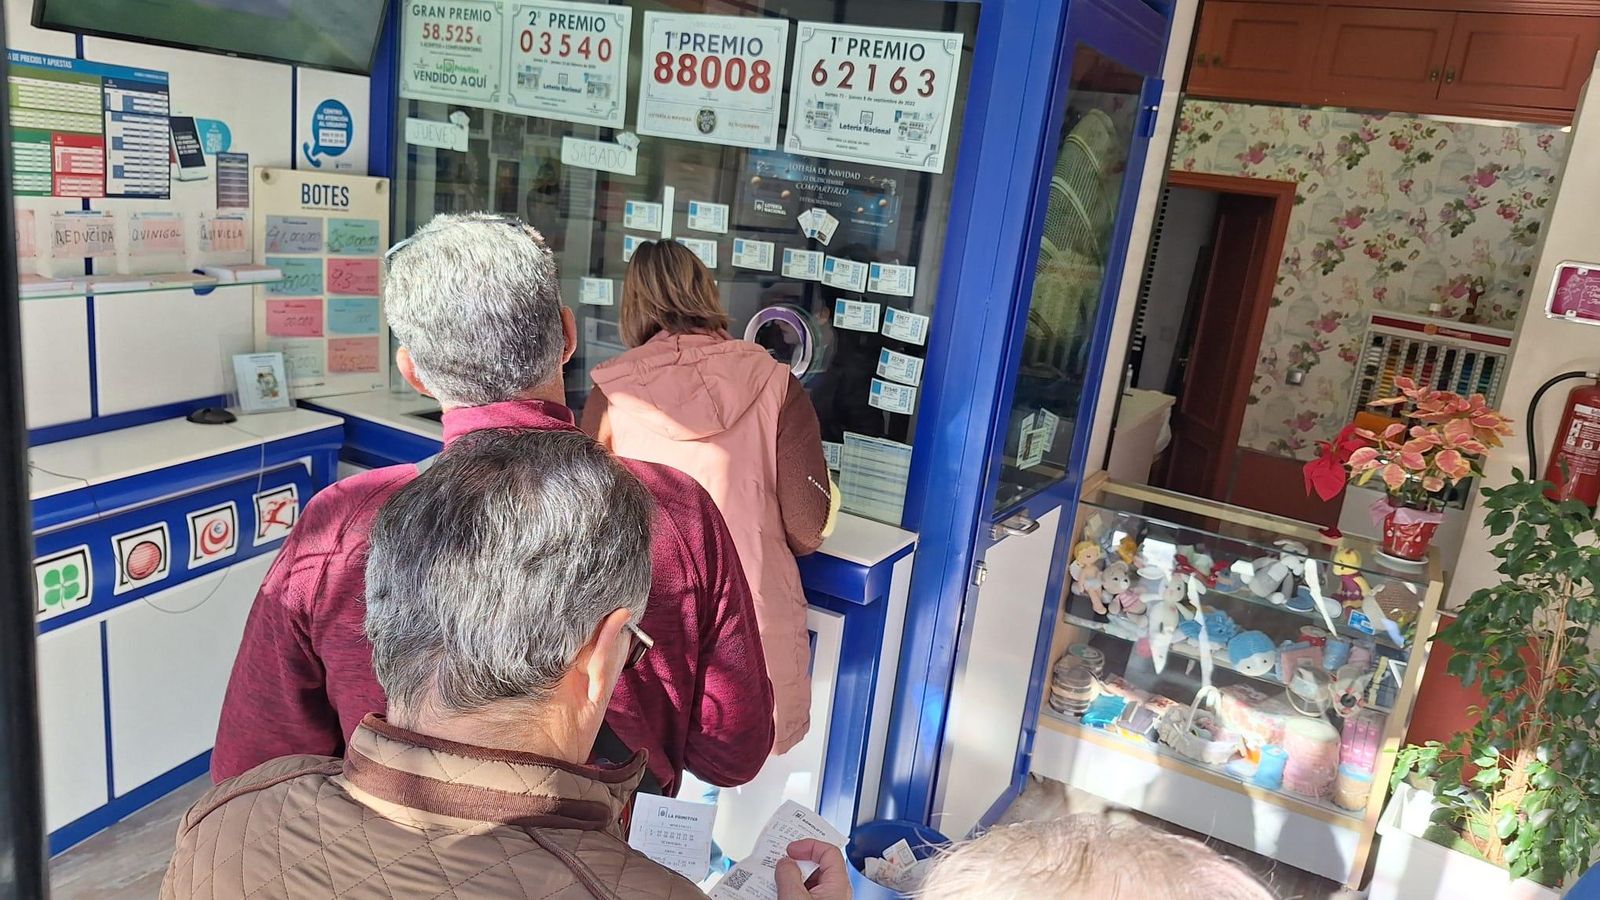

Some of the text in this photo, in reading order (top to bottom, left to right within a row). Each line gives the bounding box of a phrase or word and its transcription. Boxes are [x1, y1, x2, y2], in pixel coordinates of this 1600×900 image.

[412, 4, 492, 22] GRAN PREMIO
[549, 12, 606, 33] PREMIO
[422, 22, 473, 43] 58.525
[520, 29, 612, 62] 03540
[680, 32, 763, 57] PREMIO
[847, 38, 926, 62] PREMIO
[12, 52, 19, 61] DE
[20, 54, 42, 64] PRECIOS
[47, 58, 72, 69] APUESTAS
[413, 69, 487, 88] VENDIDO AQUÍ
[654, 51, 771, 94] 88008
[811, 59, 936, 98] 62163
[416, 123, 457, 144] JUEVES
[863, 125, 891, 135] Nacional
[789, 163, 860, 180] LOTERÍA DE NAVIDAD
[301, 183, 349, 207] BOTES
